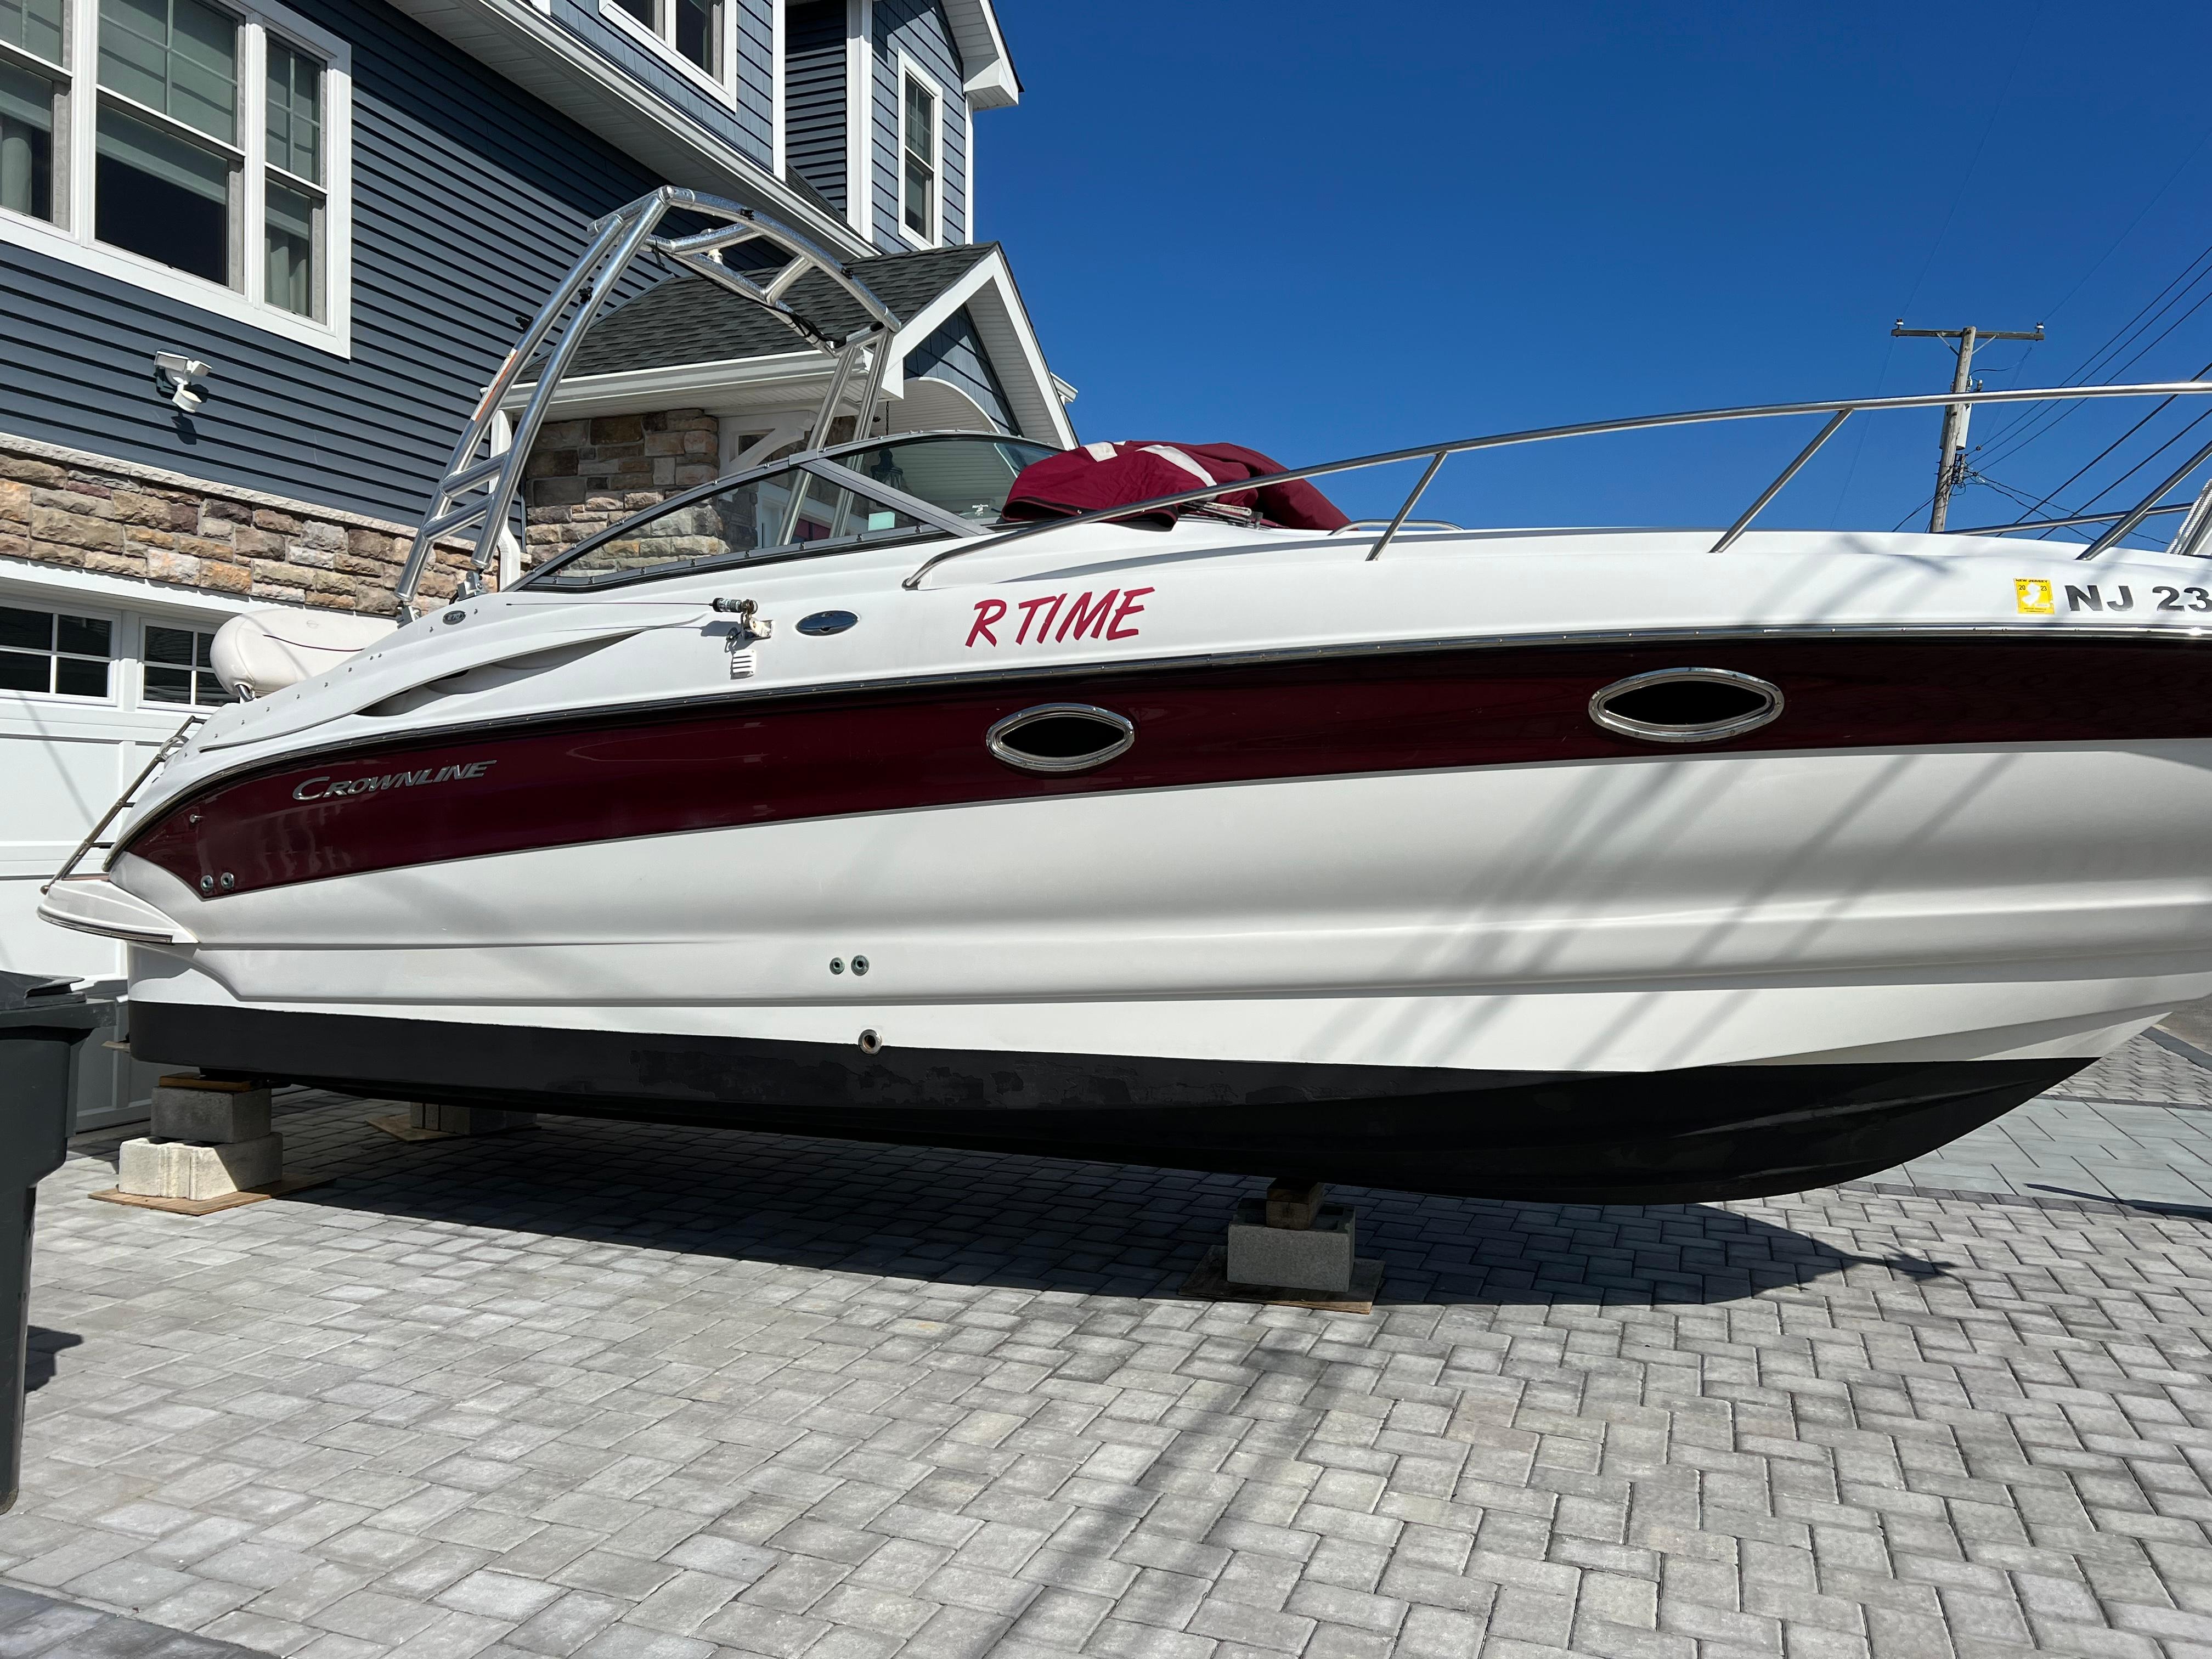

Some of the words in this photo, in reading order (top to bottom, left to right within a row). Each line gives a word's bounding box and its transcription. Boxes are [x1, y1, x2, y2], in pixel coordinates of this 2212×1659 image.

[965, 599, 1007, 648] R
[1015, 586, 1155, 646] TIME
[2064, 585, 2134, 612] NJ
[2152, 586, 2212, 612] 23
[292, 759, 498, 800] CROWNLINE
